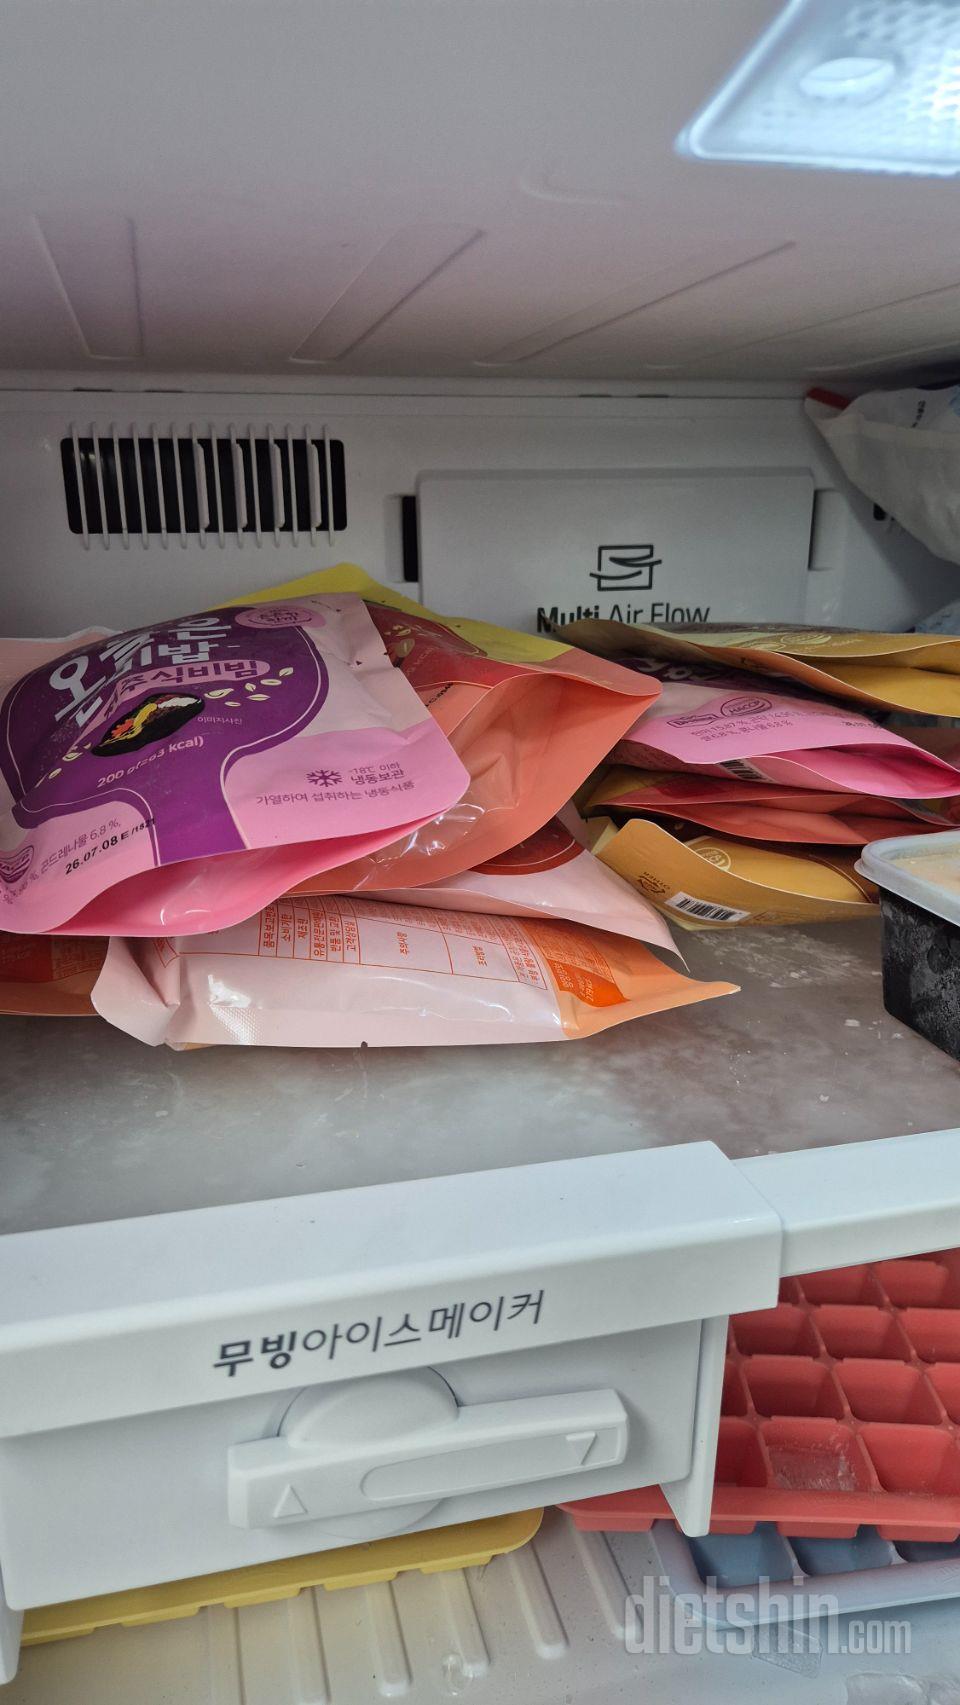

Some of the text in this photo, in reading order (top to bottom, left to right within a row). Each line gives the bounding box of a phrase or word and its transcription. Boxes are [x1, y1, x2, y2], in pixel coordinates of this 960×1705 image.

[609, 604, 643, 623] Air
[651, 602, 710, 623] Flow
[197, 716, 243, 725] 이미지사진
[97, 770, 124, 788] 200
[169, 736, 204, 752] kcal)
[379, 761, 401, 772] 이하
[350, 769, 405, 786] 냉동보관
[256, 780, 415, 806] 가열하여 섭취하는 냉동식품
[65, 835, 119, 875] 26.07.08
[120, 831, 130, 841] E
[213, 1289, 545, 1377] 무빙아이스메이커
